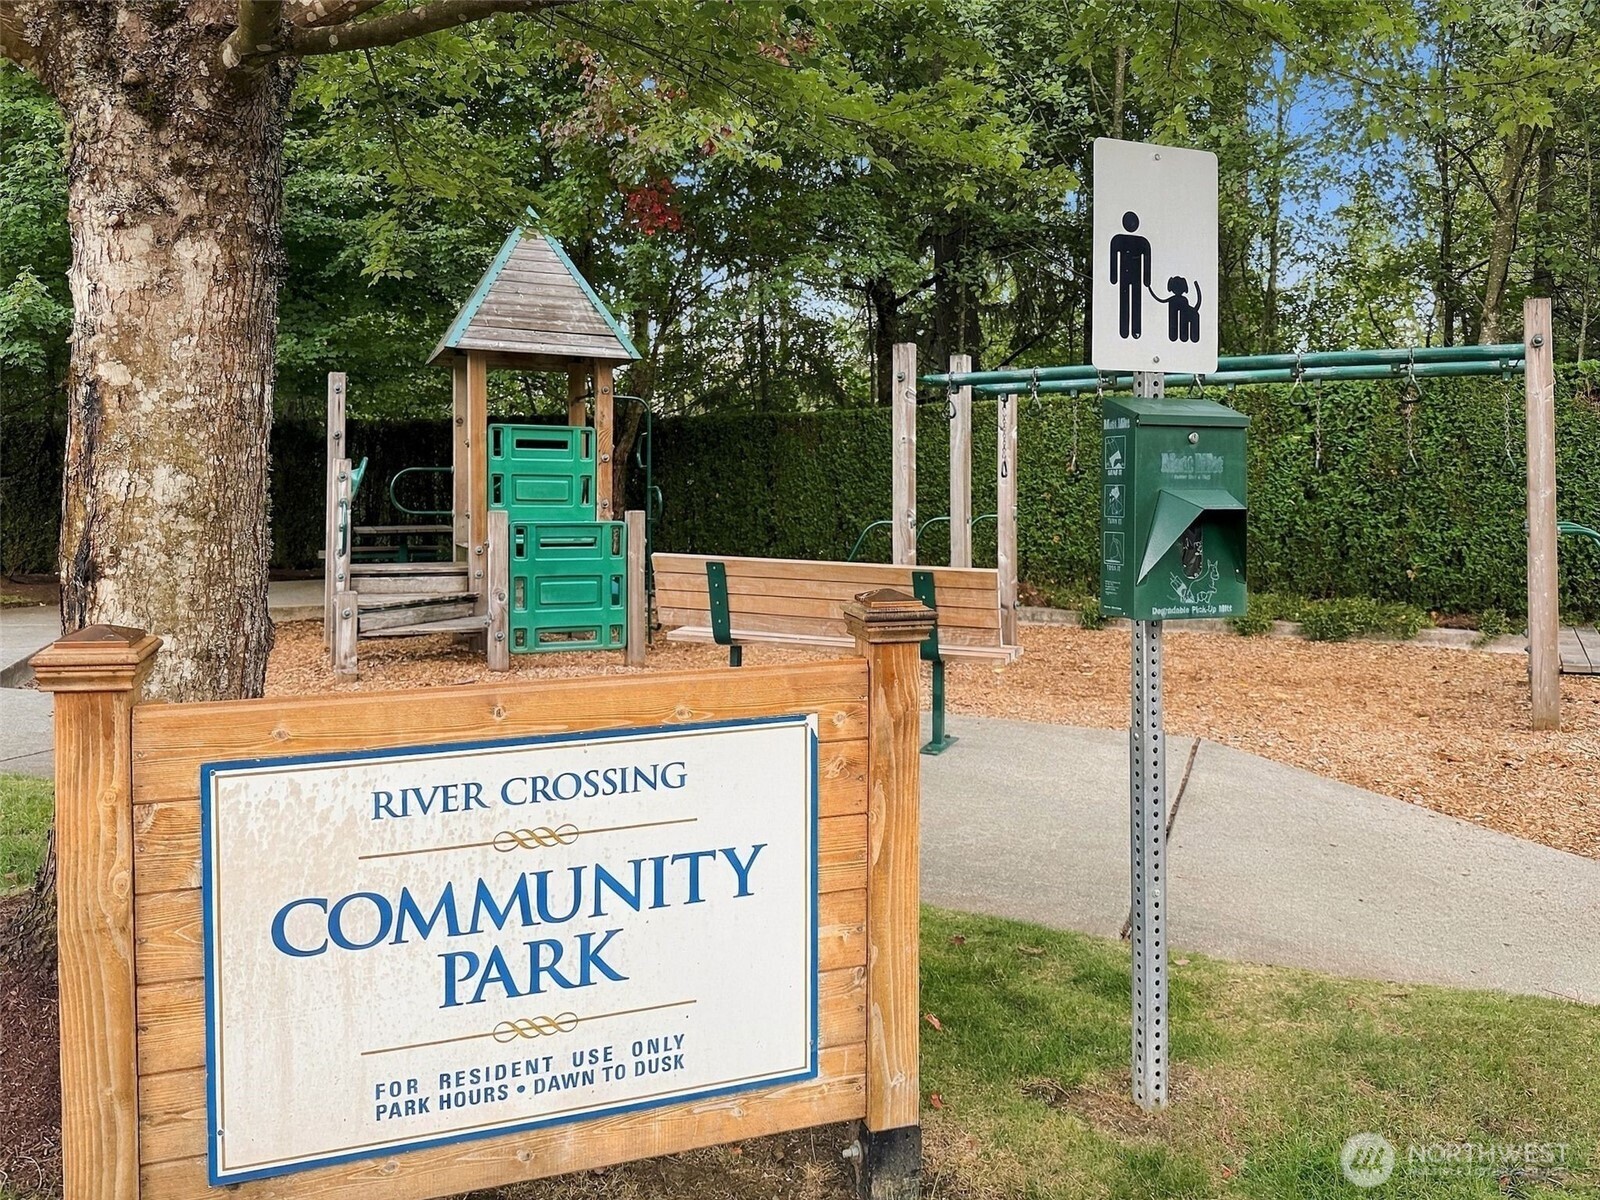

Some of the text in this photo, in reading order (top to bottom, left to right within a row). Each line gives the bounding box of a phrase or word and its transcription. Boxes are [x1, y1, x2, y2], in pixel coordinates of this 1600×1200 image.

[1151, 605, 1190, 618] Degradable
[371, 761, 687, 820] RIVER CROSSING
[270, 844, 767, 959] COMMUNITY
[439, 928, 628, 1009] PARK
[375, 1033, 685, 1100] FOR RESIDENT USE ONLY
[376, 1053, 685, 1122] PARK HOURS DAWN TO DUSK
